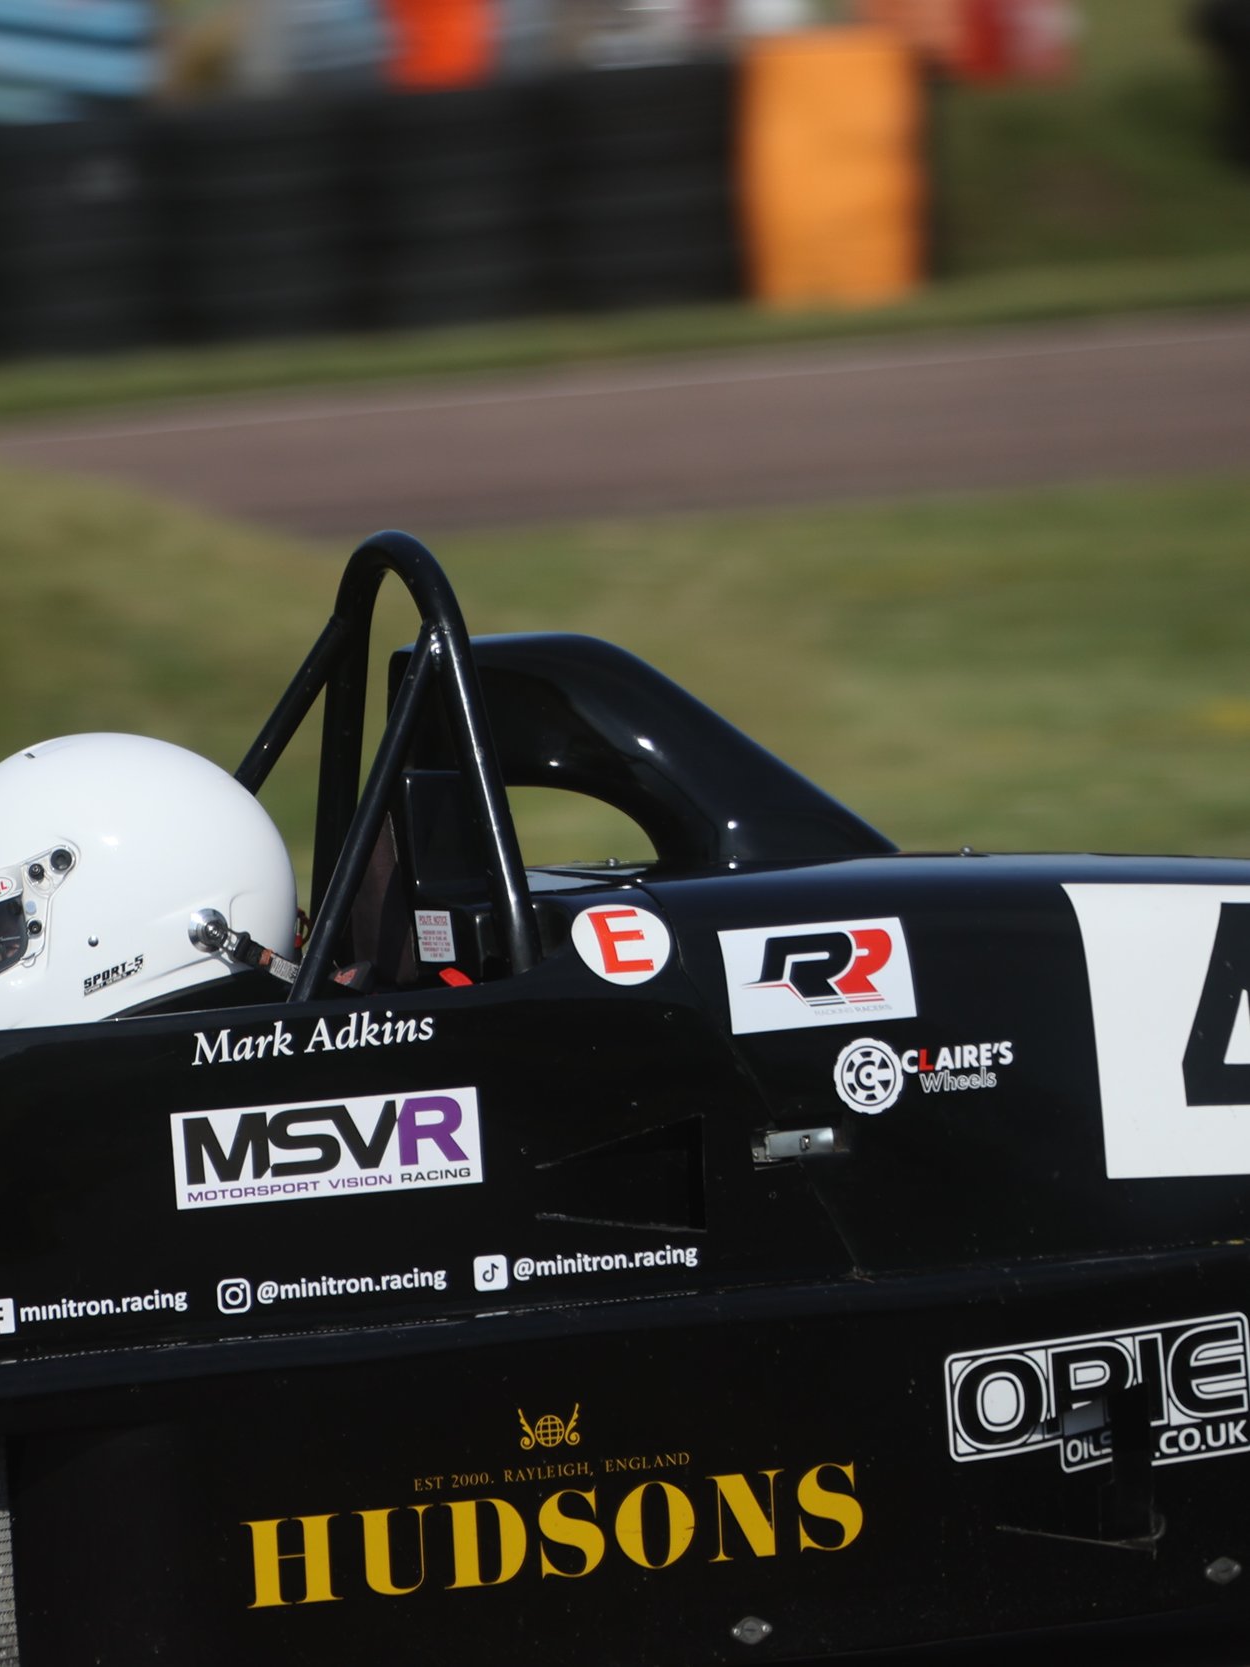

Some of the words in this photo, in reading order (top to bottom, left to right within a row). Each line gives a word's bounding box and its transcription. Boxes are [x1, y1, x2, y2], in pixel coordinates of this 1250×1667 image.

[587, 909, 655, 975] E
[191, 1020, 294, 1066] Mark
[304, 1010, 434, 1053] Adkins
[901, 1041, 1014, 1075] CLAIRE'S
[919, 1066, 997, 1093] Wheels
[182, 1095, 469, 1186] MSVR
[187, 1180, 321, 1203] MOTORSPORT
[328, 1174, 393, 1189] VISION
[400, 1167, 471, 1184] RACING
[20, 1287, 188, 1324] minitron.racing
[256, 1265, 447, 1305] @minitron.racing
[512, 1243, 698, 1282] @minitron.racing
[414, 1476, 444, 1492] EST
[452, 1472, 494, 1488] 2000.
[504, 1462, 594, 1482] RAYLEIGH,
[605, 1452, 690, 1472] ENGLAND
[240, 1460, 865, 1609] HUDSONS
